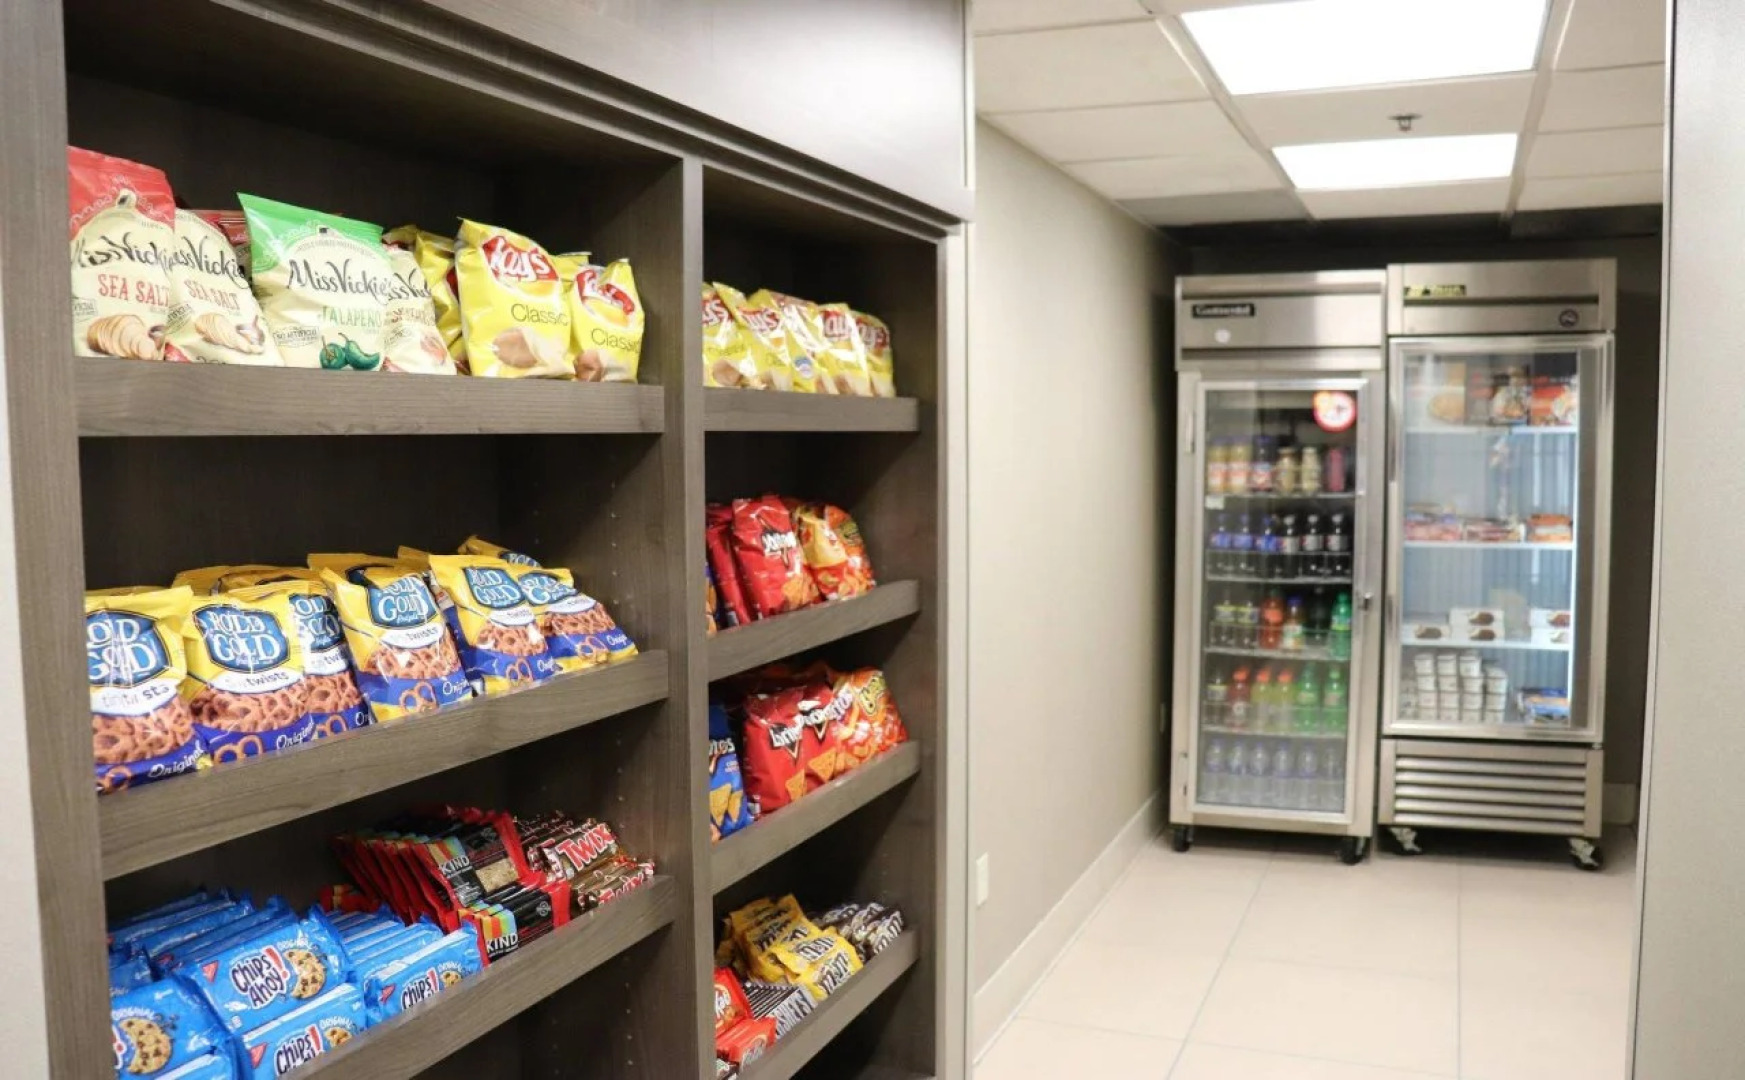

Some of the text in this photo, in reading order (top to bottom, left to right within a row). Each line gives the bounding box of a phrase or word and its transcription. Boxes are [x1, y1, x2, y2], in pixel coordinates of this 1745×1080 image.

[489, 235, 550, 282] Lay's
[97, 274, 129, 301] SEA
[286, 258, 340, 291] Miss
[184, 279, 241, 311] SEA SALT
[510, 303, 569, 327] Classic
[378, 594, 429, 621] GOLD
[473, 584, 522, 605] GOLD
[213, 632, 281, 662] GOLD
[246, 671, 290, 687] twists
[147, 738, 205, 778] Original
[439, 854, 470, 877] KIND
[485, 933, 519, 954] KIND
[231, 953, 272, 993] Chips
[248, 950, 290, 1008] Ahoy!
